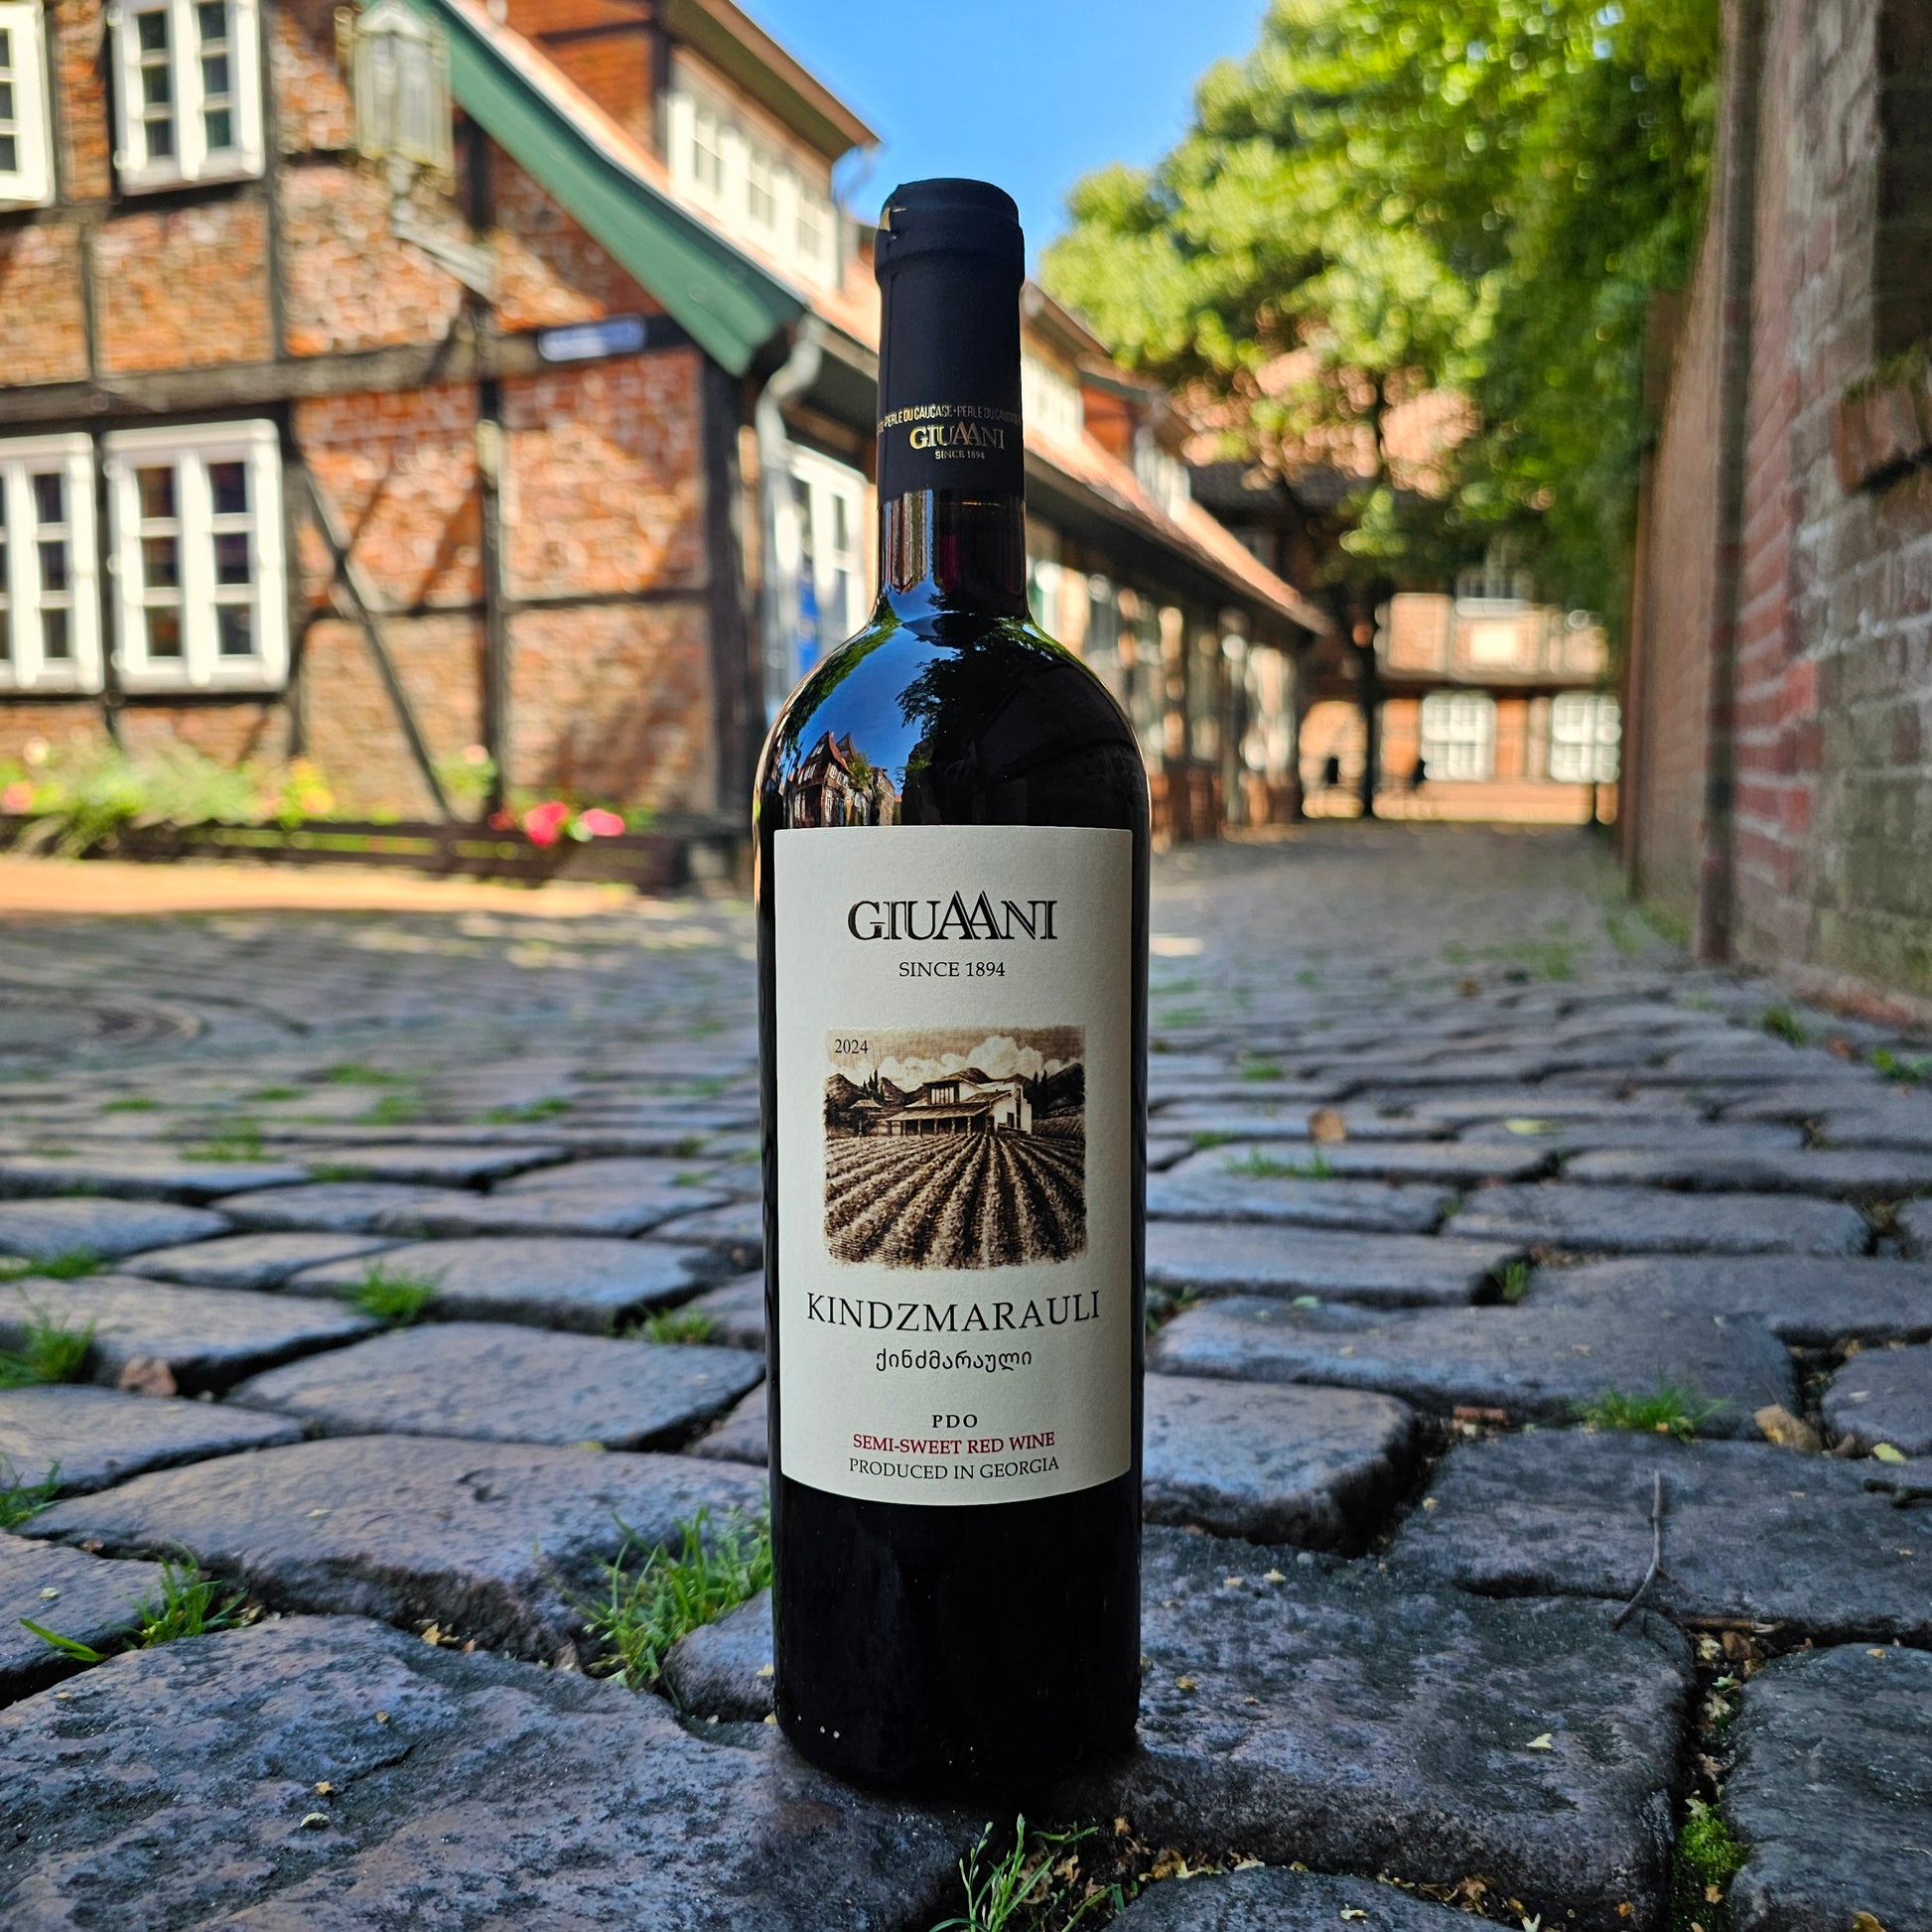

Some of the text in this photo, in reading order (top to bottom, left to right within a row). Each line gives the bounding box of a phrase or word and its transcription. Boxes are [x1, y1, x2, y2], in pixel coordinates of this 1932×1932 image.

[903, 407, 913, 422] DU
[957, 405, 983, 419] PERLE
[935, 450, 985, 460] SINCE 1894
[898, 962, 1006, 978] SINCE 1894
[834, 1038, 869, 1054] 2024
[807, 1291, 1100, 1332] KINDZMARAULI
[876, 1348, 1032, 1373] ქინძმარაული
[932, 1414, 978, 1429] PDO
[853, 1432, 1055, 1454] SEMI-SWEET RED WINE
[849, 1455, 1059, 1479] PRODUCED IN GEORGIA
